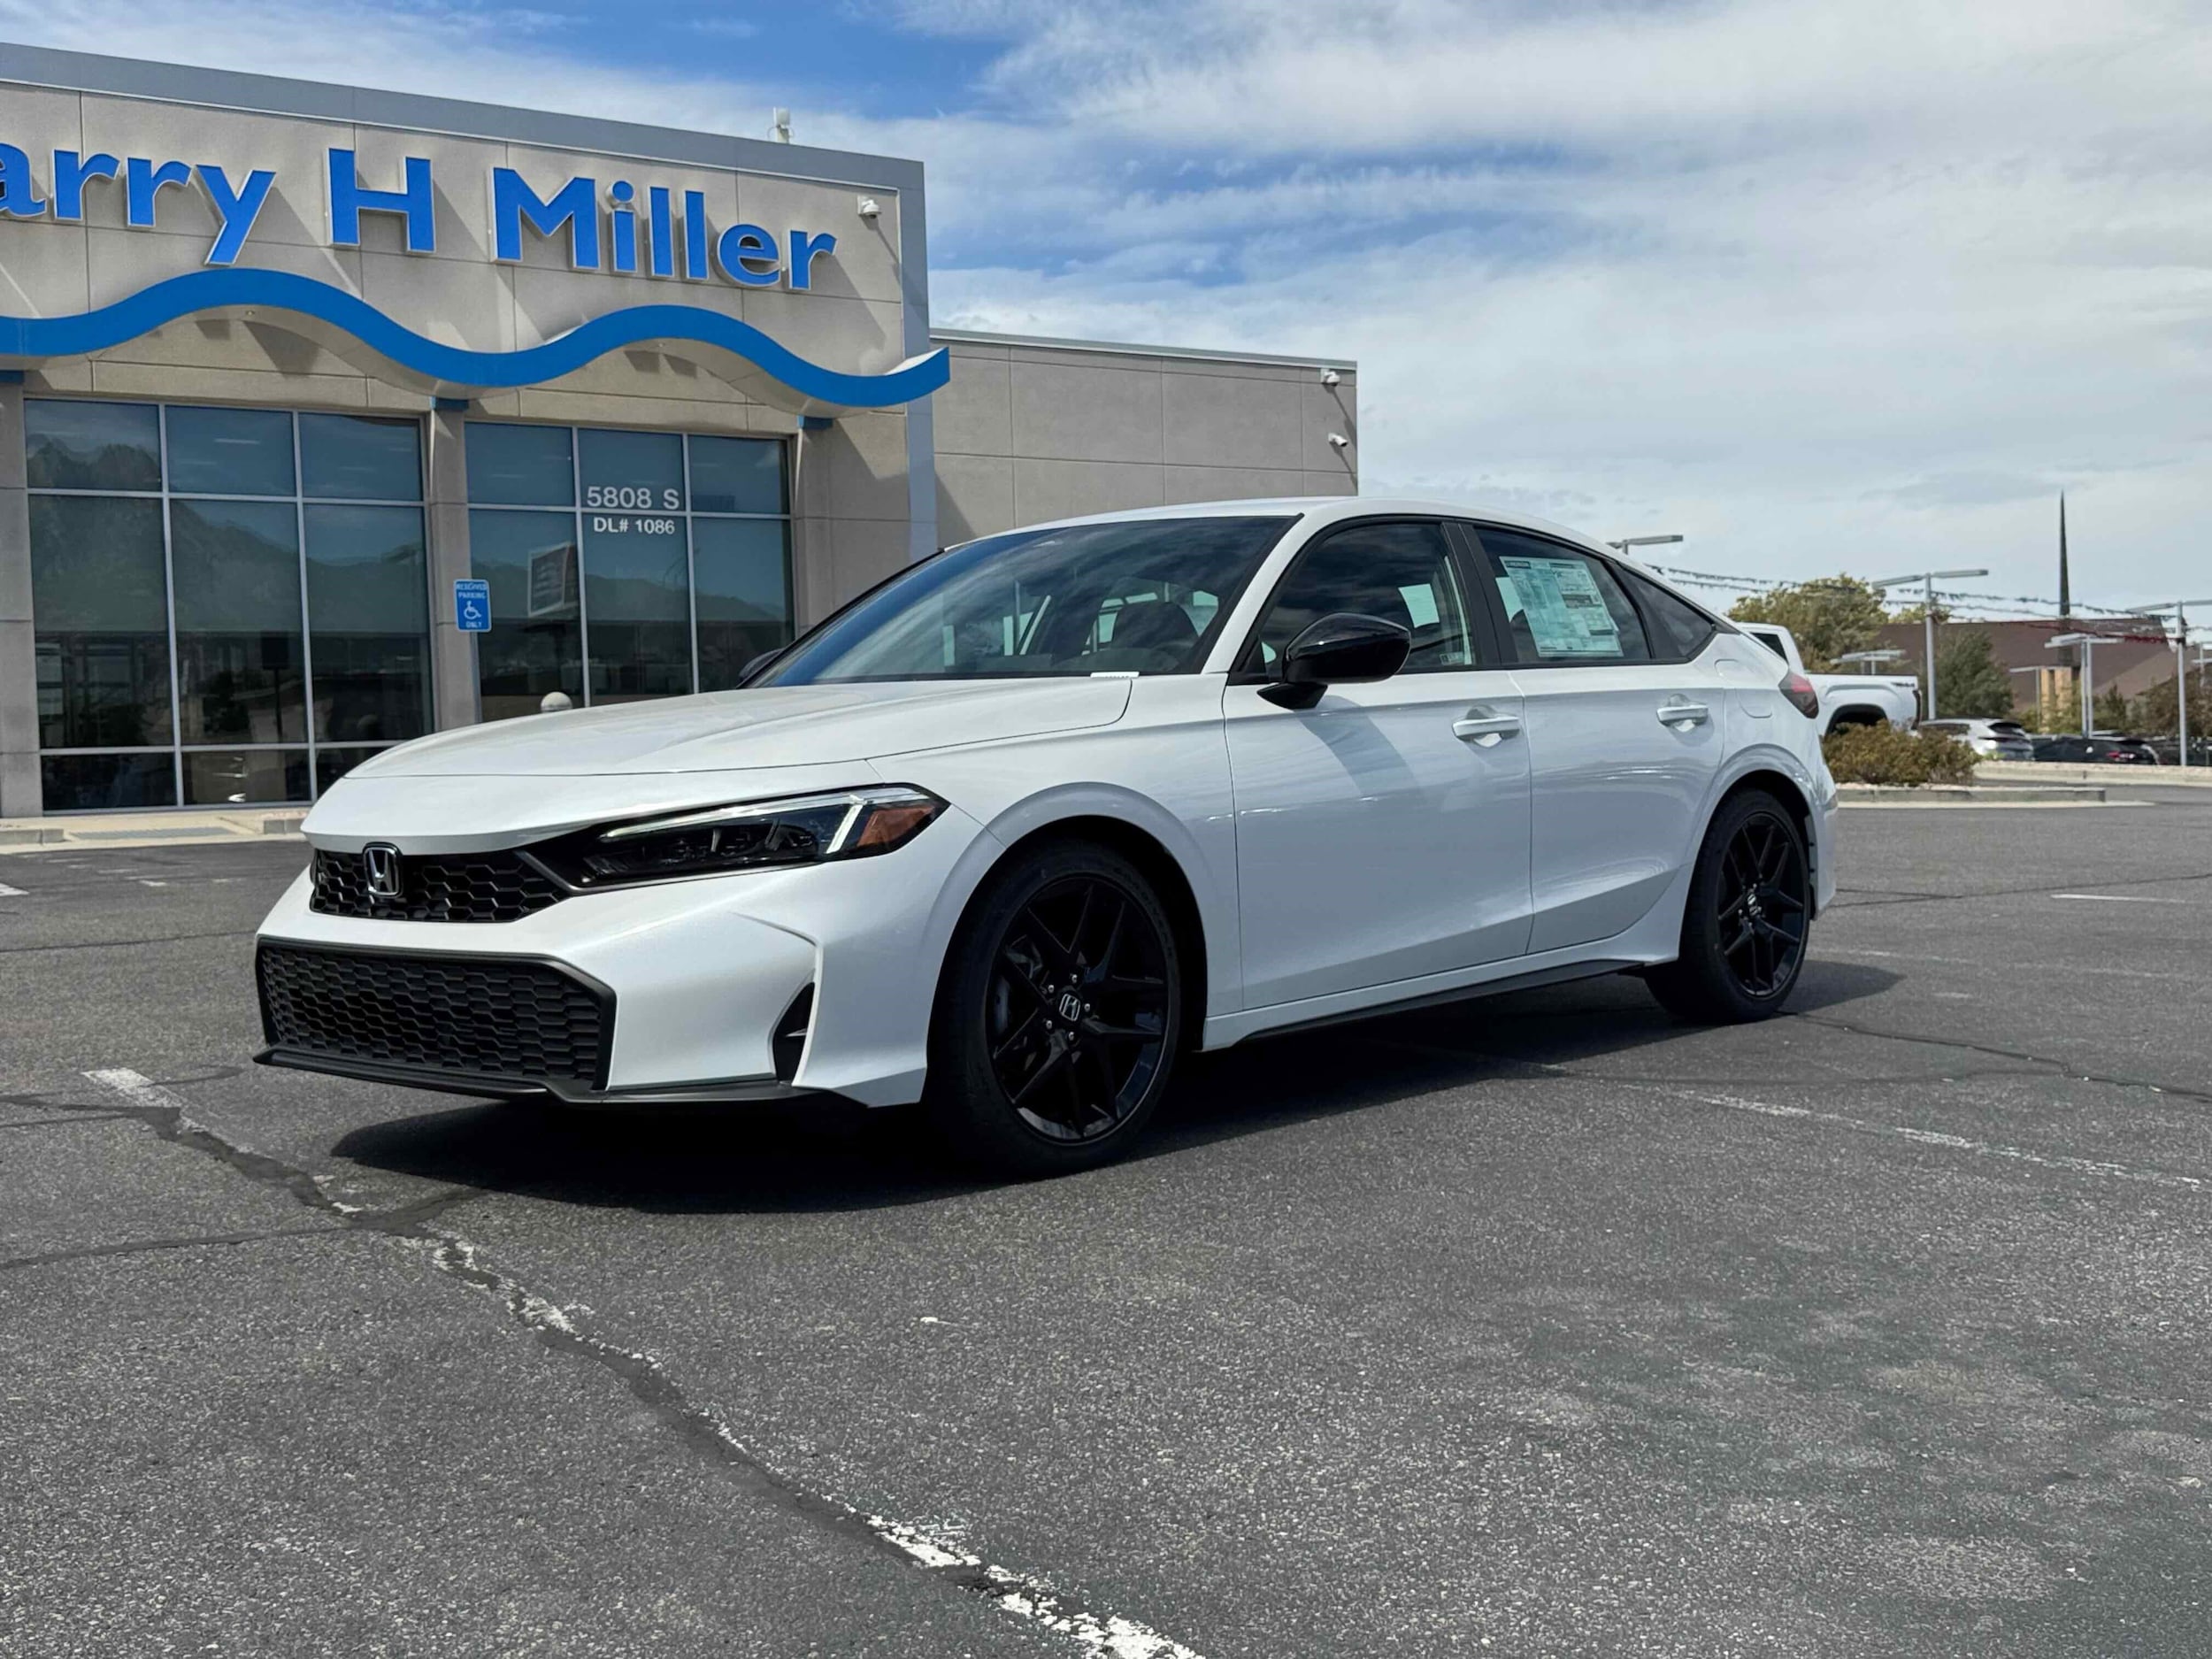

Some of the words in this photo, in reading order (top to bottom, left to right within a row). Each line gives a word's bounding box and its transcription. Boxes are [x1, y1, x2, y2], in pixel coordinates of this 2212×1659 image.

[324, 147, 436, 254] H
[491, 165, 838, 291] Miller
[587, 486, 653, 509] 5808
[663, 488, 680, 510] S
[594, 517, 629, 533] DL#
[635, 518, 675, 534] 1086
